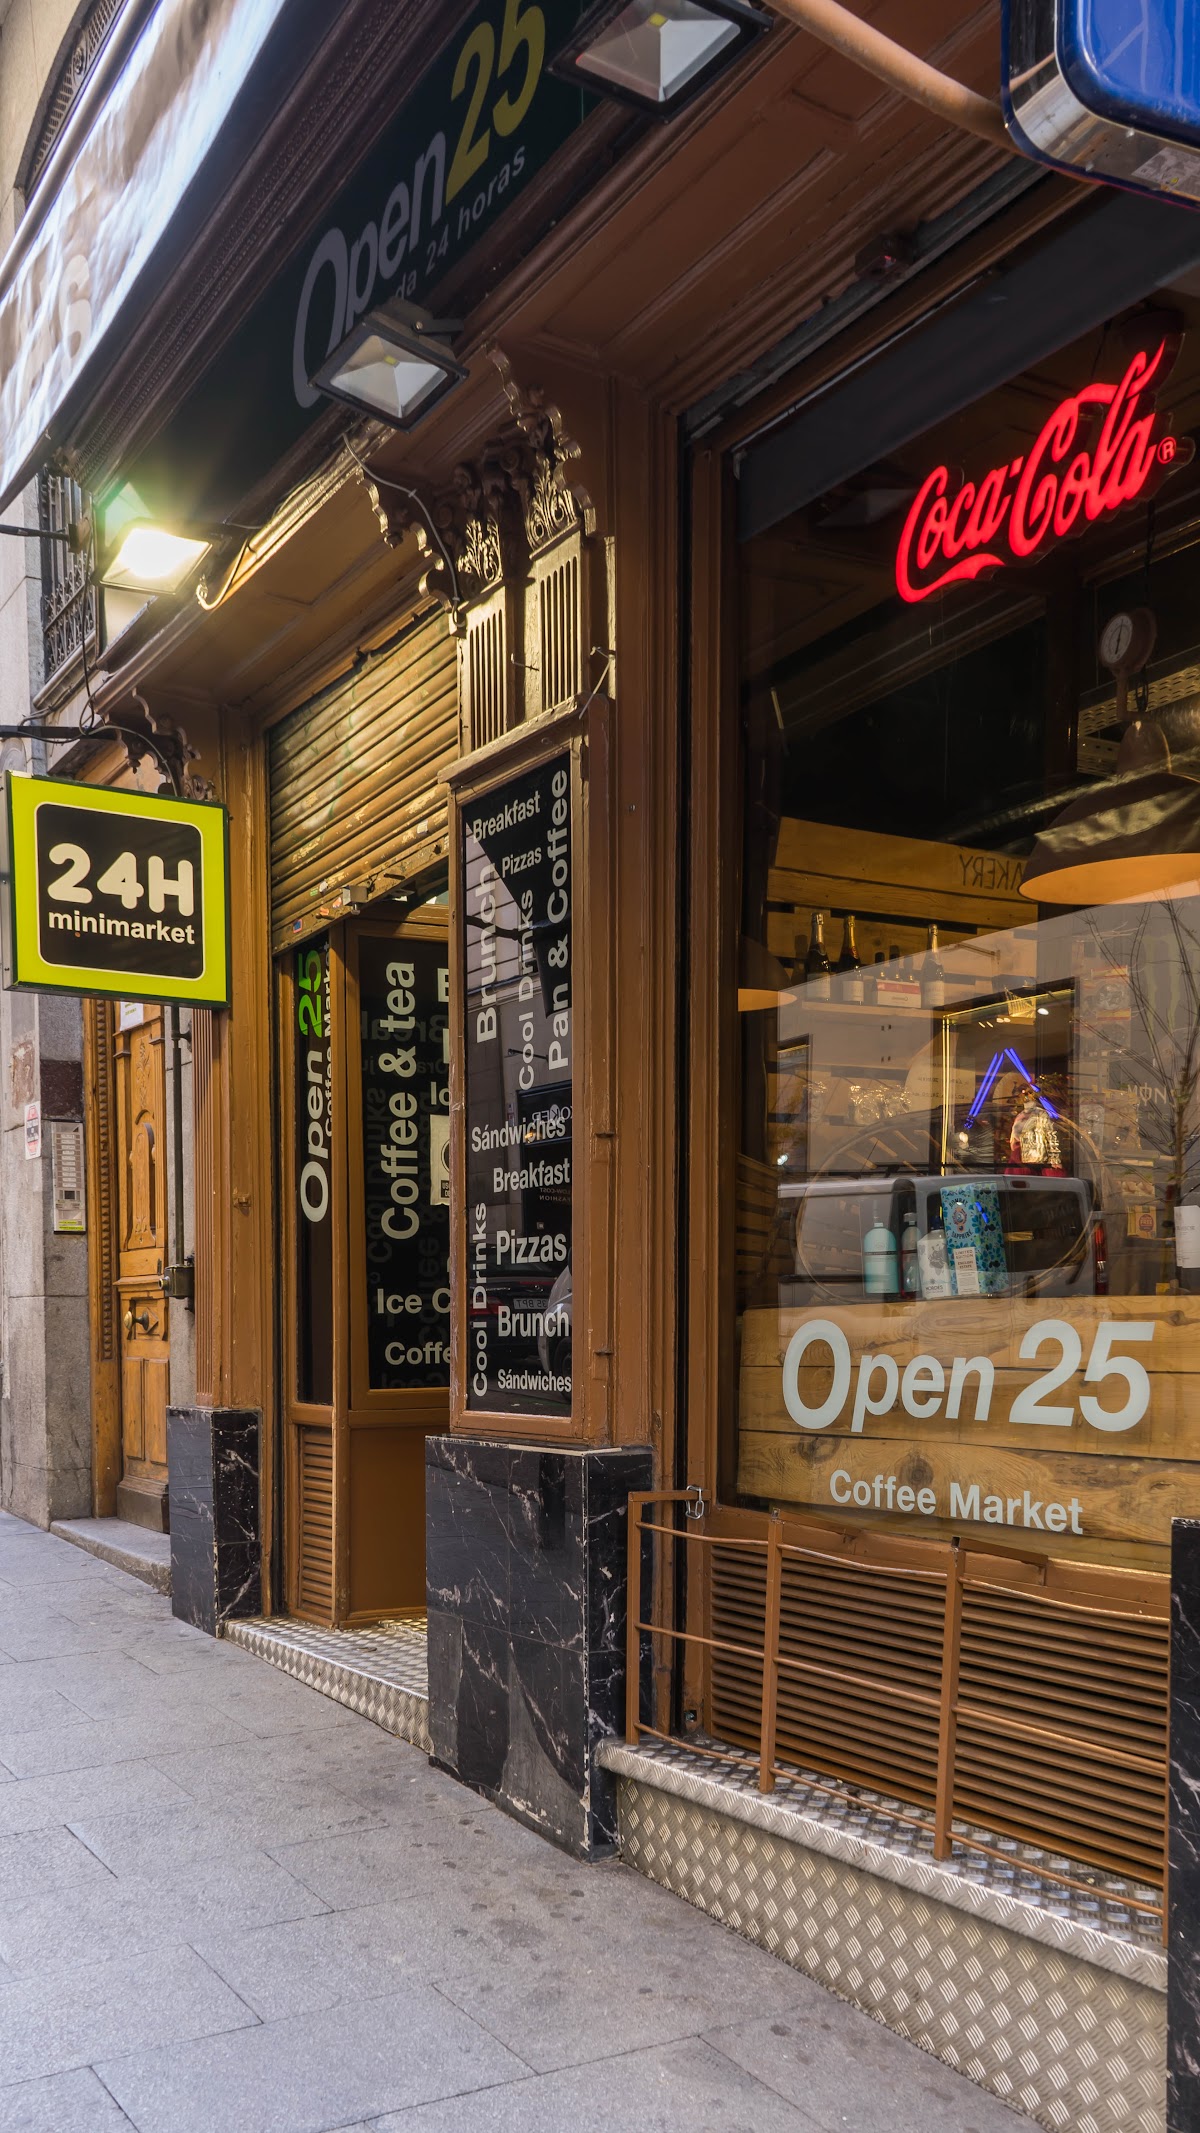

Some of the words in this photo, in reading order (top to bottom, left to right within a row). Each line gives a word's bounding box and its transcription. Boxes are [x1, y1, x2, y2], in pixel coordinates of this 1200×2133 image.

[293, 131, 446, 408] Open
[445, 0, 546, 206] 25
[425, 224, 449, 277] 24
[457, 145, 526, 240] horas
[896, 335, 1165, 602] Coca-Cola
[472, 790, 541, 844] Breakfast
[547, 769, 568, 924] Coffee
[47, 842, 195, 917] 24H
[501, 846, 542, 878] Pizzas
[48, 910, 195, 945] minimarket
[476, 863, 498, 1043] Brunch
[518, 889, 533, 1002] Drinks
[548, 933, 569, 968] &
[298, 950, 322, 1037] 25
[380, 962, 415, 1032] tea
[547, 982, 569, 1071] Pan
[378, 1046, 416, 1078] &
[519, 1011, 534, 1091] Cool
[300, 1050, 329, 1222] Open
[381, 1091, 420, 1240] Coffee
[471, 1116, 566, 1153] Sándwiches
[493, 1158, 570, 1193] Breakfast
[472, 1202, 487, 1309] Drinks
[496, 1229, 567, 1266] Pizzas
[376, 1288, 422, 1314] Ice
[498, 1306, 570, 1337] Brunch
[473, 1321, 488, 1396] Cool
[497, 1369, 572, 1393] Sándwiches
[782, 1319, 995, 1433] Open
[1009, 1319, 1155, 1432] 25
[829, 1469, 937, 1515] Coffee
[949, 1482, 1083, 1535] Market
